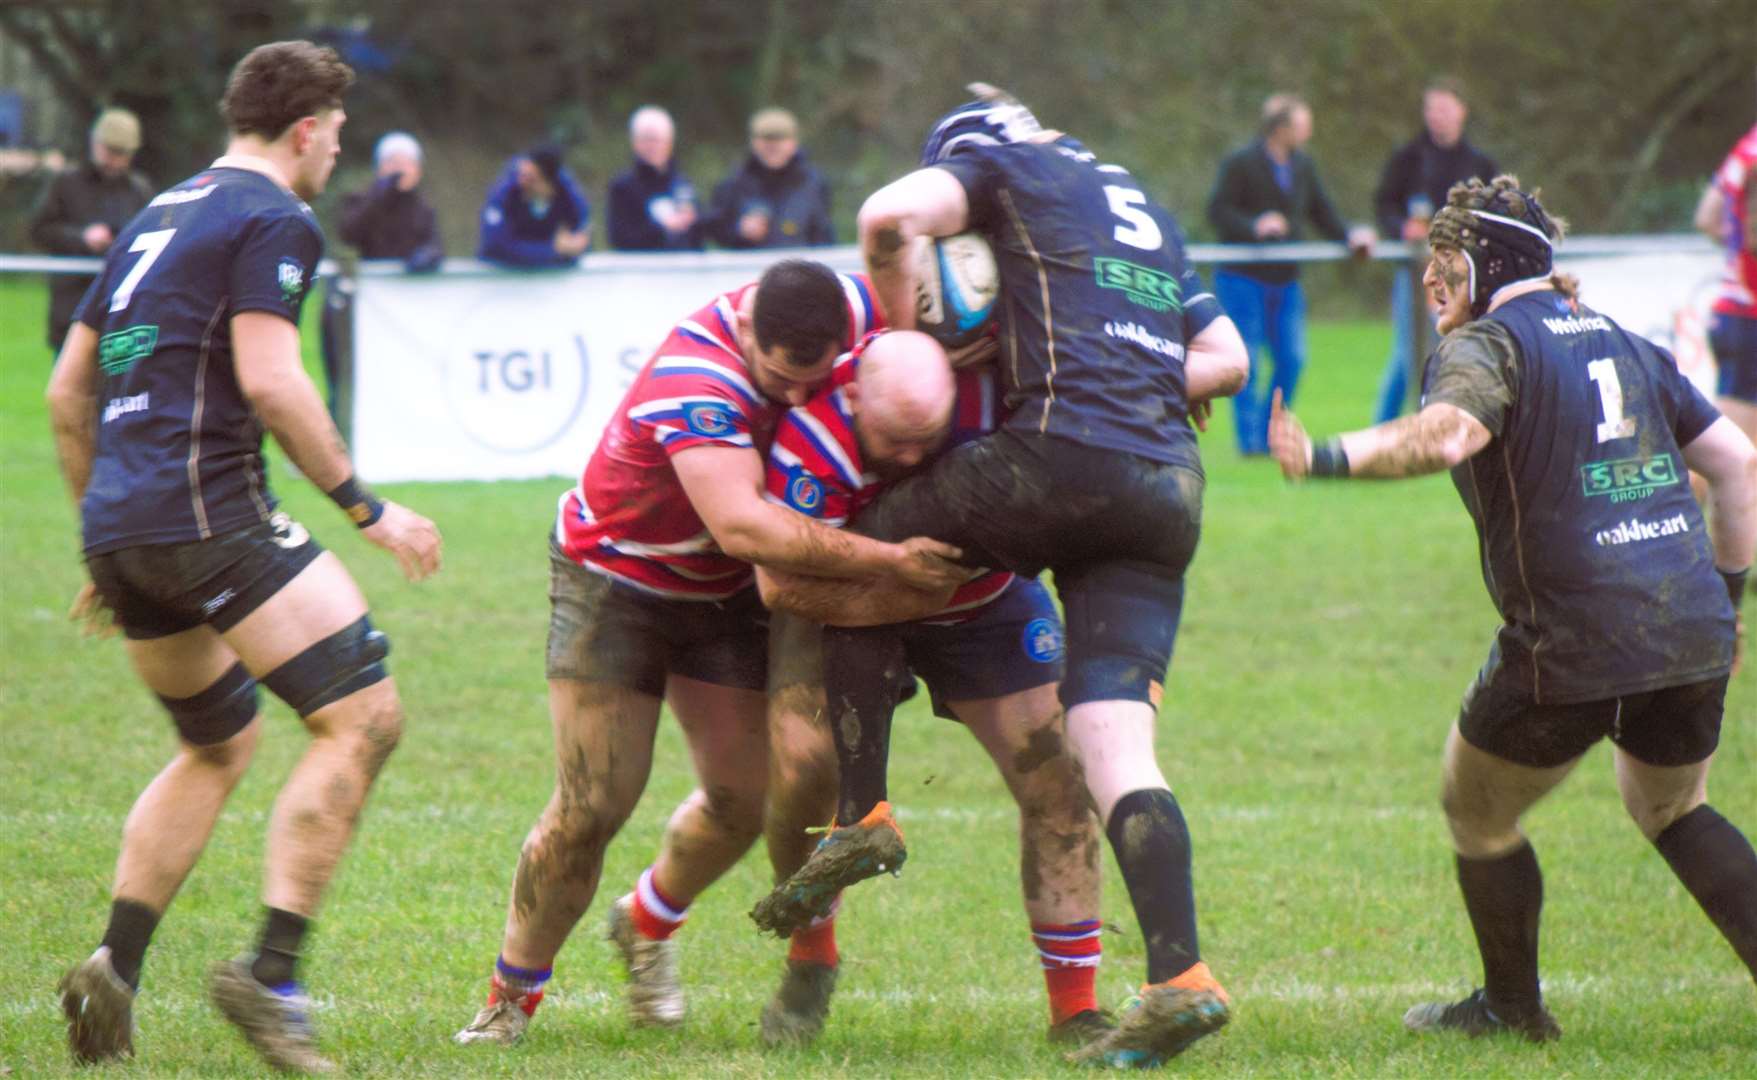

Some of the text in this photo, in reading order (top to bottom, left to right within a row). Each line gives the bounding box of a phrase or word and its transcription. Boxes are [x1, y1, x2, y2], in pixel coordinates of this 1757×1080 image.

[1102, 184, 1163, 251] 5
[108, 228, 177, 313] 7
[473, 350, 553, 392] TGI
[1587, 358, 1636, 444] 1
[1591, 459, 1670, 489] SRC
[1596, 512, 1689, 546] oakheart
